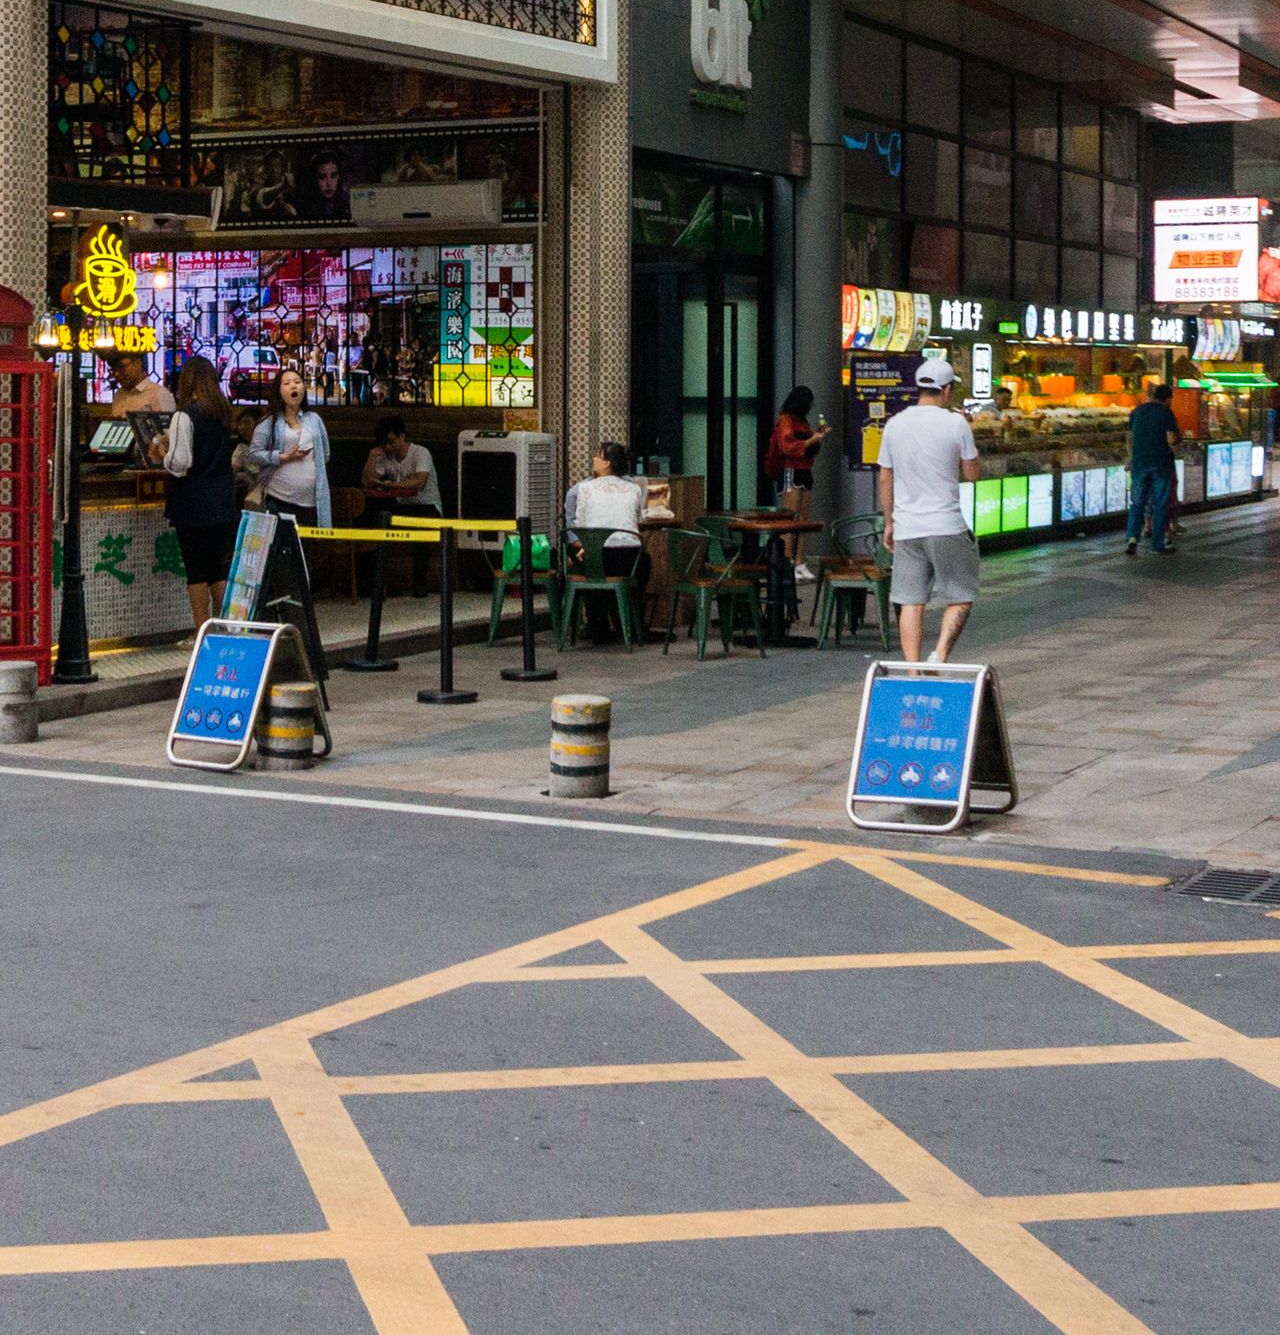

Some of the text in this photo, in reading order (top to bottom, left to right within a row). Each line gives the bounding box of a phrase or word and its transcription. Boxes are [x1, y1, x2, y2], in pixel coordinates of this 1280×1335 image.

[1203, 205, 1253, 217] 诚聘英才
[1176, 251, 1236, 266] 物业主管
[1175, 287, 1239, 297] 88383188
[214, 664, 238, 681] 禁止
[900, 712, 936, 731] 禁止
